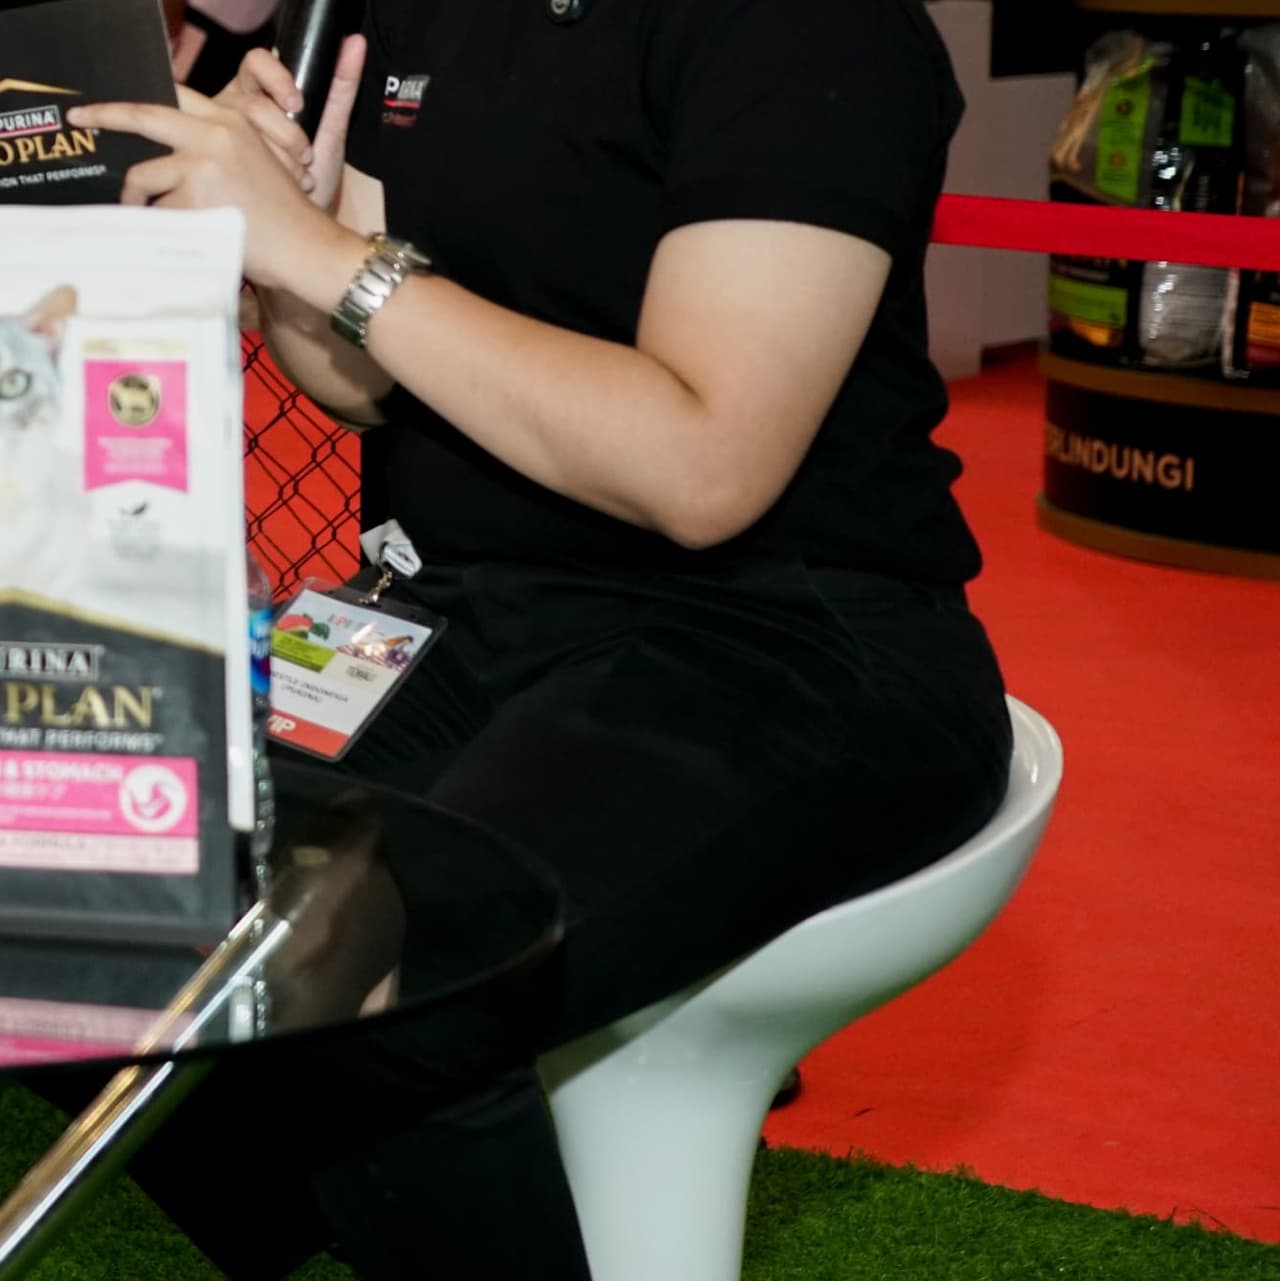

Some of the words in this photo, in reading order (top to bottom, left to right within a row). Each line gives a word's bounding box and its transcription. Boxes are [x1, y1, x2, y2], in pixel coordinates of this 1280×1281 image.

[15, 129, 96, 163] PLAN
[19, 172, 45, 186] THAT
[5, 680, 153, 729] PLAN
[23, 758, 124, 781] STOMACH
